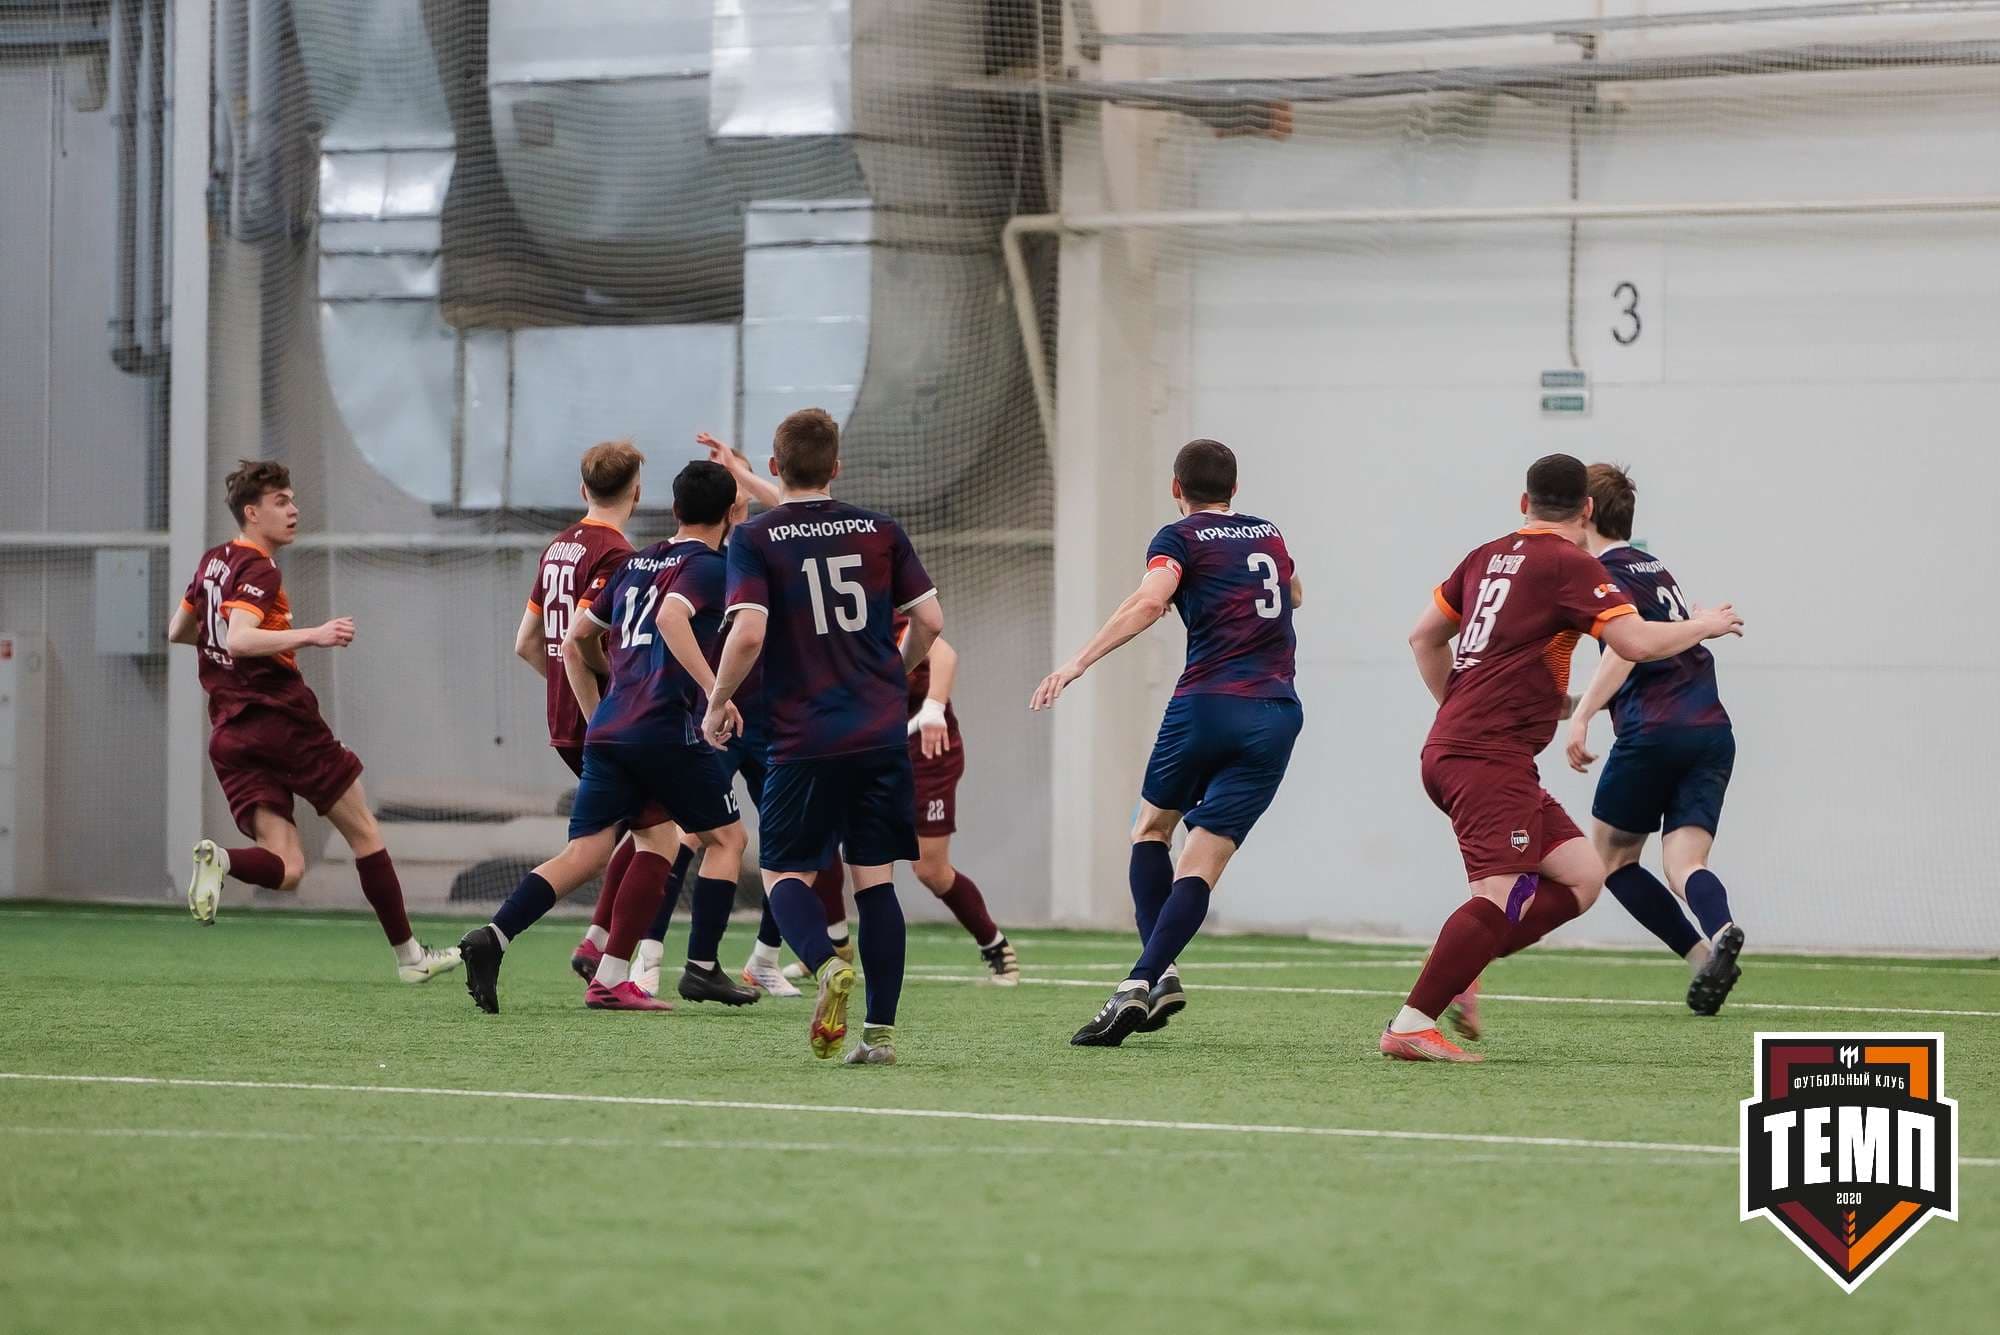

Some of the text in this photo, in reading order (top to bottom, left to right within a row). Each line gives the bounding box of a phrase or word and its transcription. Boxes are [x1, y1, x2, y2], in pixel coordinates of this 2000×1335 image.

[1611, 281, 1641, 345] 3
[768, 518, 878, 542] КРАСНОЯРСК
[1195, 523, 1280, 542] КРАСНОЯРС
[543, 563, 575, 640] 25
[621, 585, 658, 649] 12
[801, 554, 868, 635] 15
[1247, 553, 1282, 619] 3
[1459, 578, 1511, 654] 13
[723, 789, 739, 814] 12
[927, 800, 945, 821] 22
